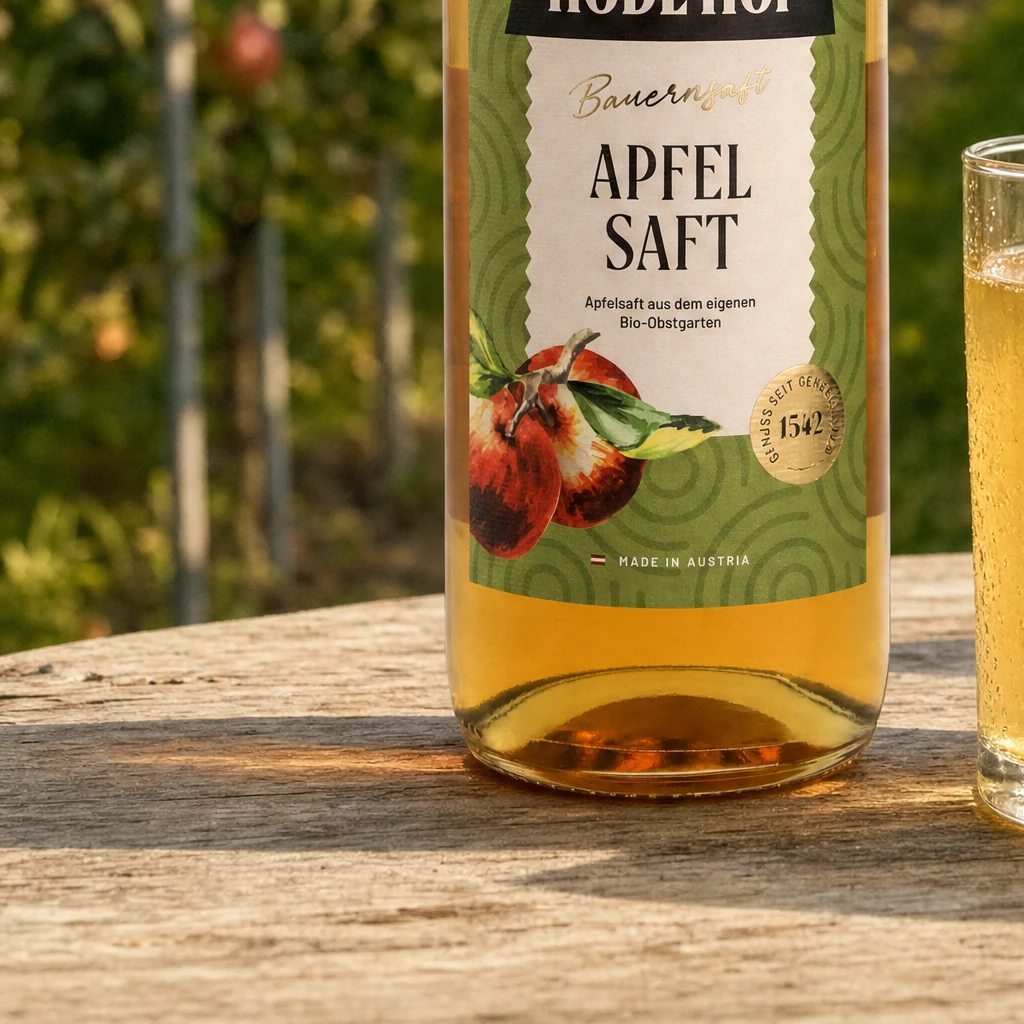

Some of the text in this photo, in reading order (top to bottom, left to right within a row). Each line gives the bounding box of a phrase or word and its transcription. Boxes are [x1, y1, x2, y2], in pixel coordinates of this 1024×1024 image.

[568, 68, 773, 120] Bauernsaft
[590, 143, 752, 200] APFEL
[605, 213, 739, 271] SAFT
[585, 295, 756, 312] Apfelsaft aus dem eigenen
[620, 316, 722, 332] Bio-Obstgarten
[768, 379, 793, 407] SEIT
[779, 410, 824, 440] 1542
[619, 554, 750, 568] MADE IN AUSTRIA
